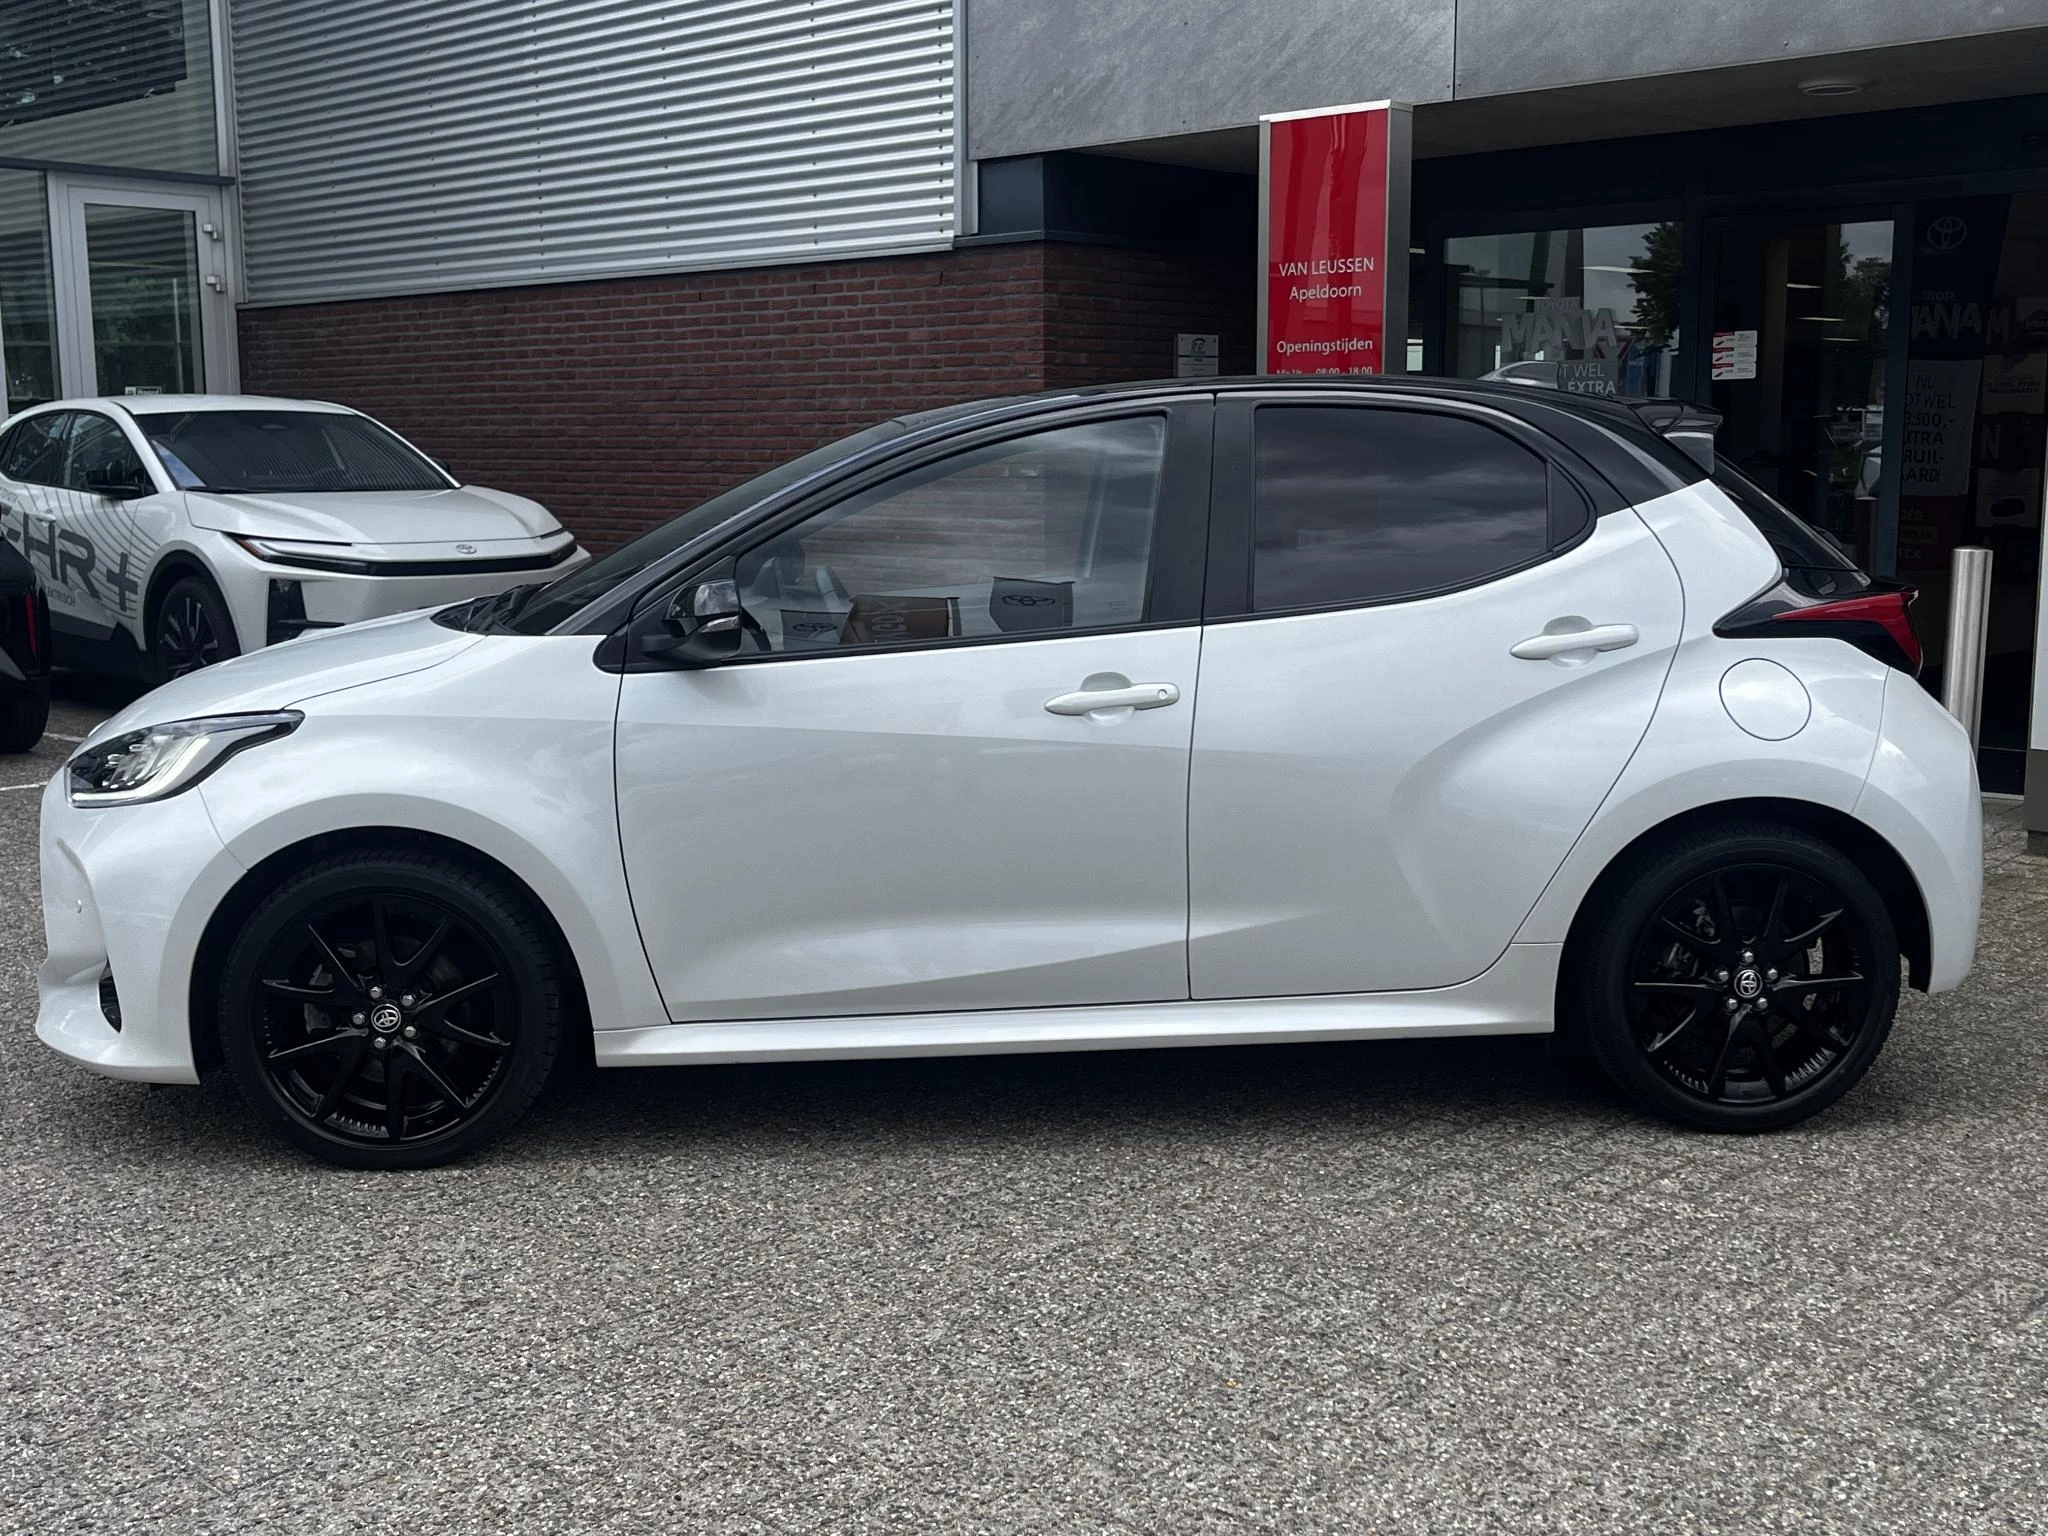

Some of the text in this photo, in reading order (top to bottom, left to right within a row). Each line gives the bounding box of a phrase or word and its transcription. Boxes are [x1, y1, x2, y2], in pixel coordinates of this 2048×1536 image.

[1279, 257, 1375, 277] VAN LEUSSEN
[1289, 284, 1362, 303] Apeldoorn
[1536, 297, 1580, 310] TOYOTA
[1276, 338, 1373, 356] Openingstijden
[1573, 363, 1605, 378] WEL
[1916, 375, 1937, 389] NU
[1923, 393, 1957, 409] WEL
[0, 502, 138, 613] -HR+
